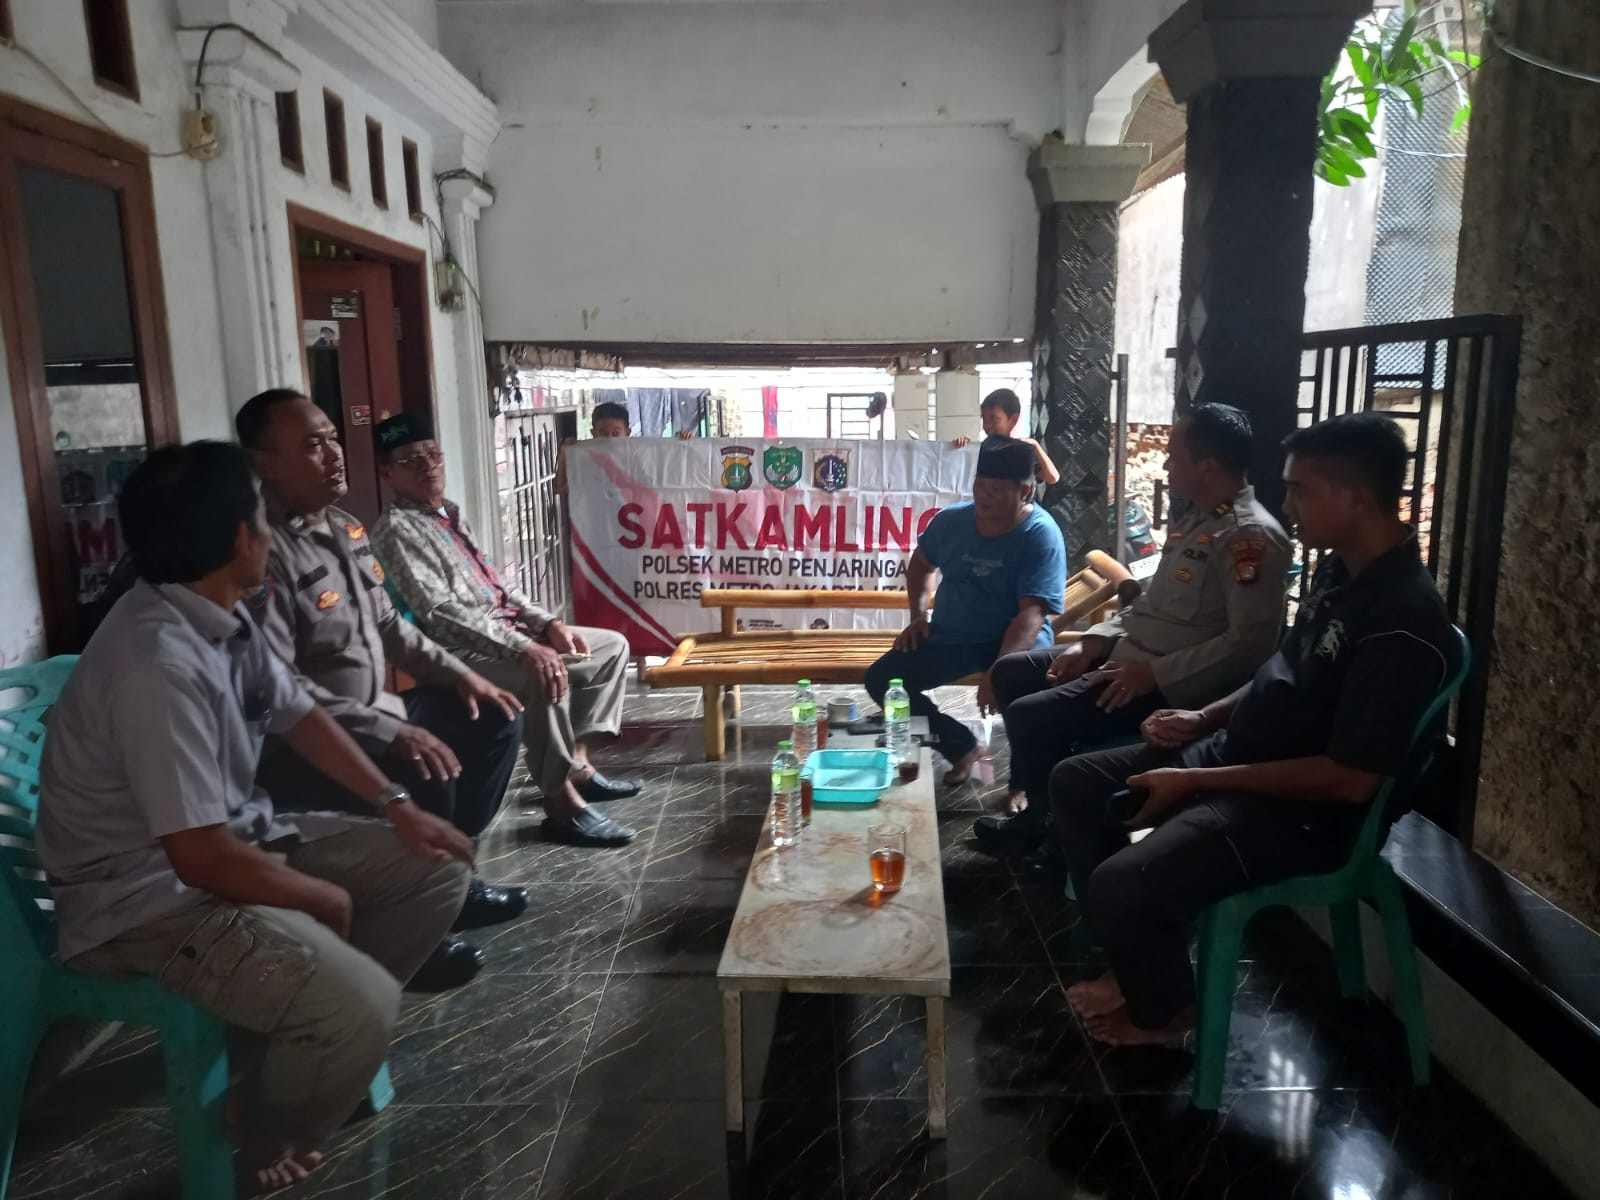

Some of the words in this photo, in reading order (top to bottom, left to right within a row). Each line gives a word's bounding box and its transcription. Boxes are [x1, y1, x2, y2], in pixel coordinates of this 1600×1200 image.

[642, 556, 714, 574] POLSEK
[720, 557, 782, 575] METRO
[634, 581, 703, 600] POLRES
